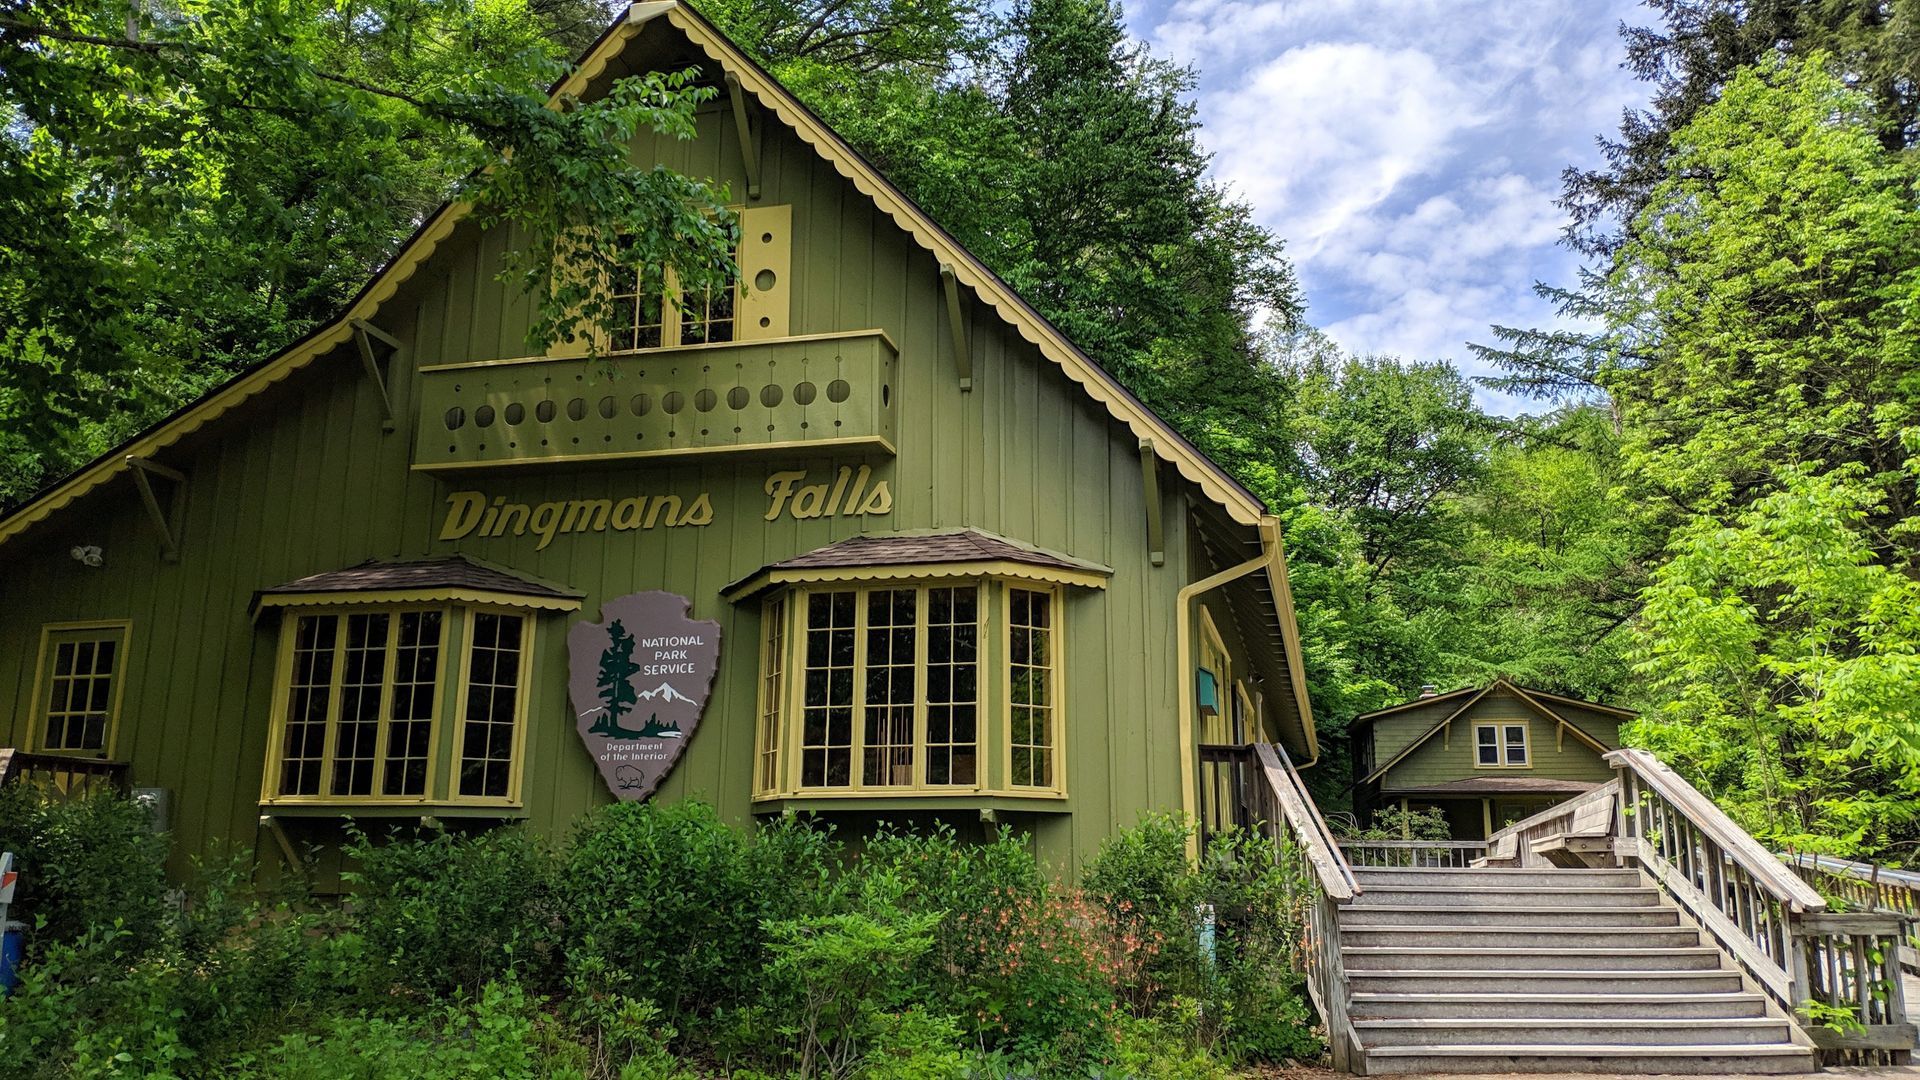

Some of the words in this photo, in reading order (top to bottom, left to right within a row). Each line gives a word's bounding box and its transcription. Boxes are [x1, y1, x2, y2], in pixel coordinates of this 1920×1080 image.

[439, 491, 714, 552] Dingmans
[764, 464, 893, 522] Falls
[642, 635, 704, 648] NATIONAL
[654, 649, 688, 661] PARK
[643, 662, 696, 676] SERVICE
[606, 742, 663, 753] Department
[600, 753, 610, 762] of
[613, 752, 629, 761] the
[631, 751, 668, 761] Interior
